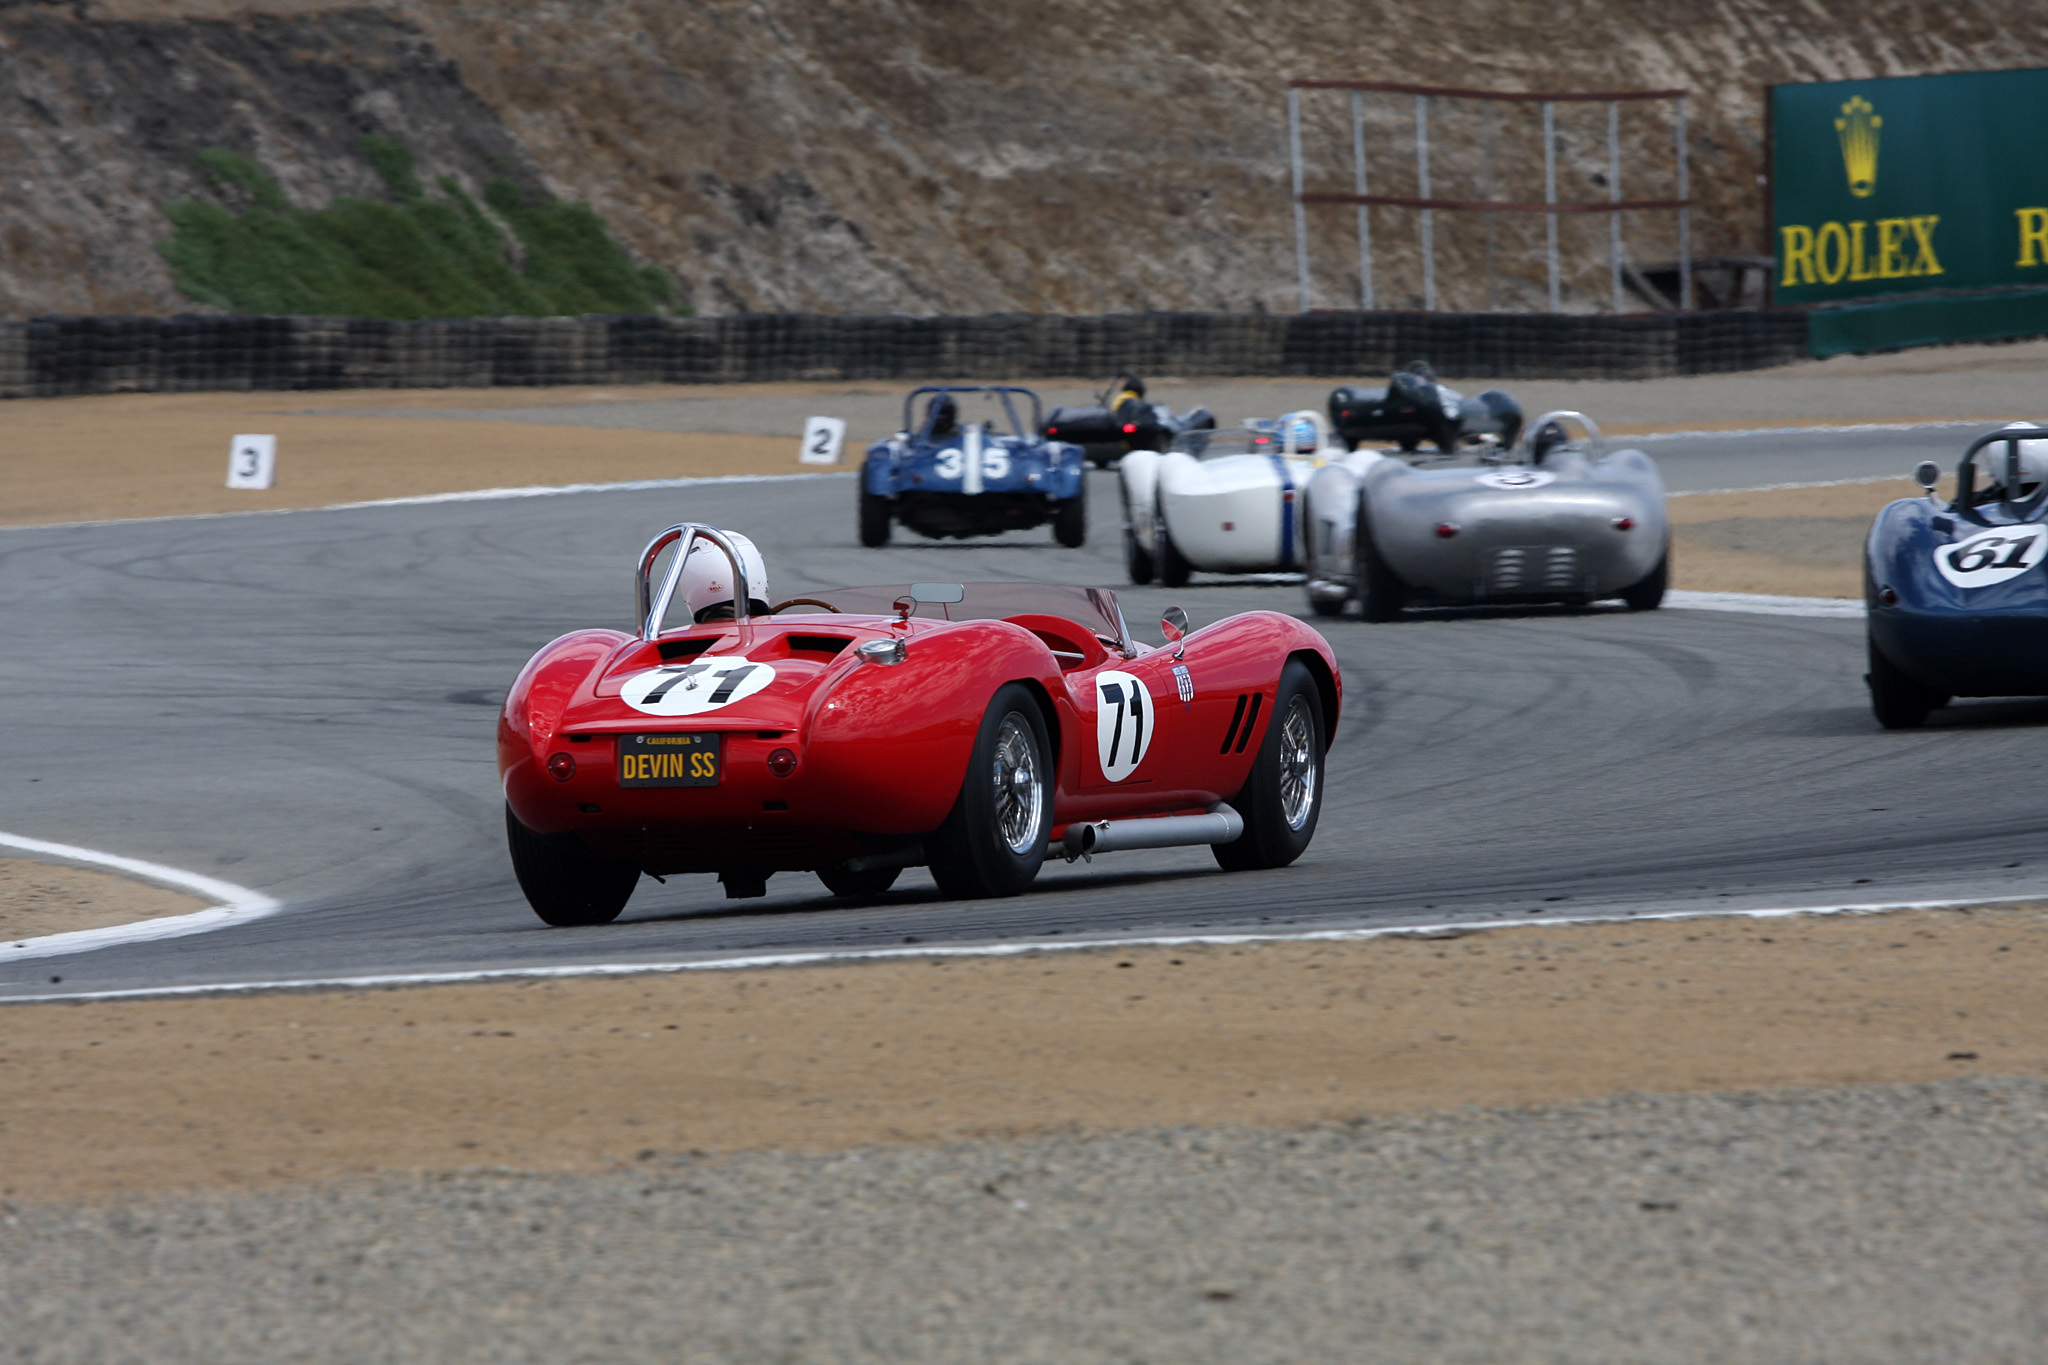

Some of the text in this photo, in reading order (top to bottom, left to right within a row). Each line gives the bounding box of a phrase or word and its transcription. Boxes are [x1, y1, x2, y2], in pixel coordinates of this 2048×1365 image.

[1780, 214, 1945, 286] ROLEX
[812, 428, 833, 455] 2
[238, 446, 261, 479] 3
[1948, 534, 2040, 573] 61
[640, 664, 760, 704] 71
[646, 736, 691, 746] CALIFORNIA
[1099, 679, 1144, 768] 71
[623, 752, 716, 780] DEVIN SS
